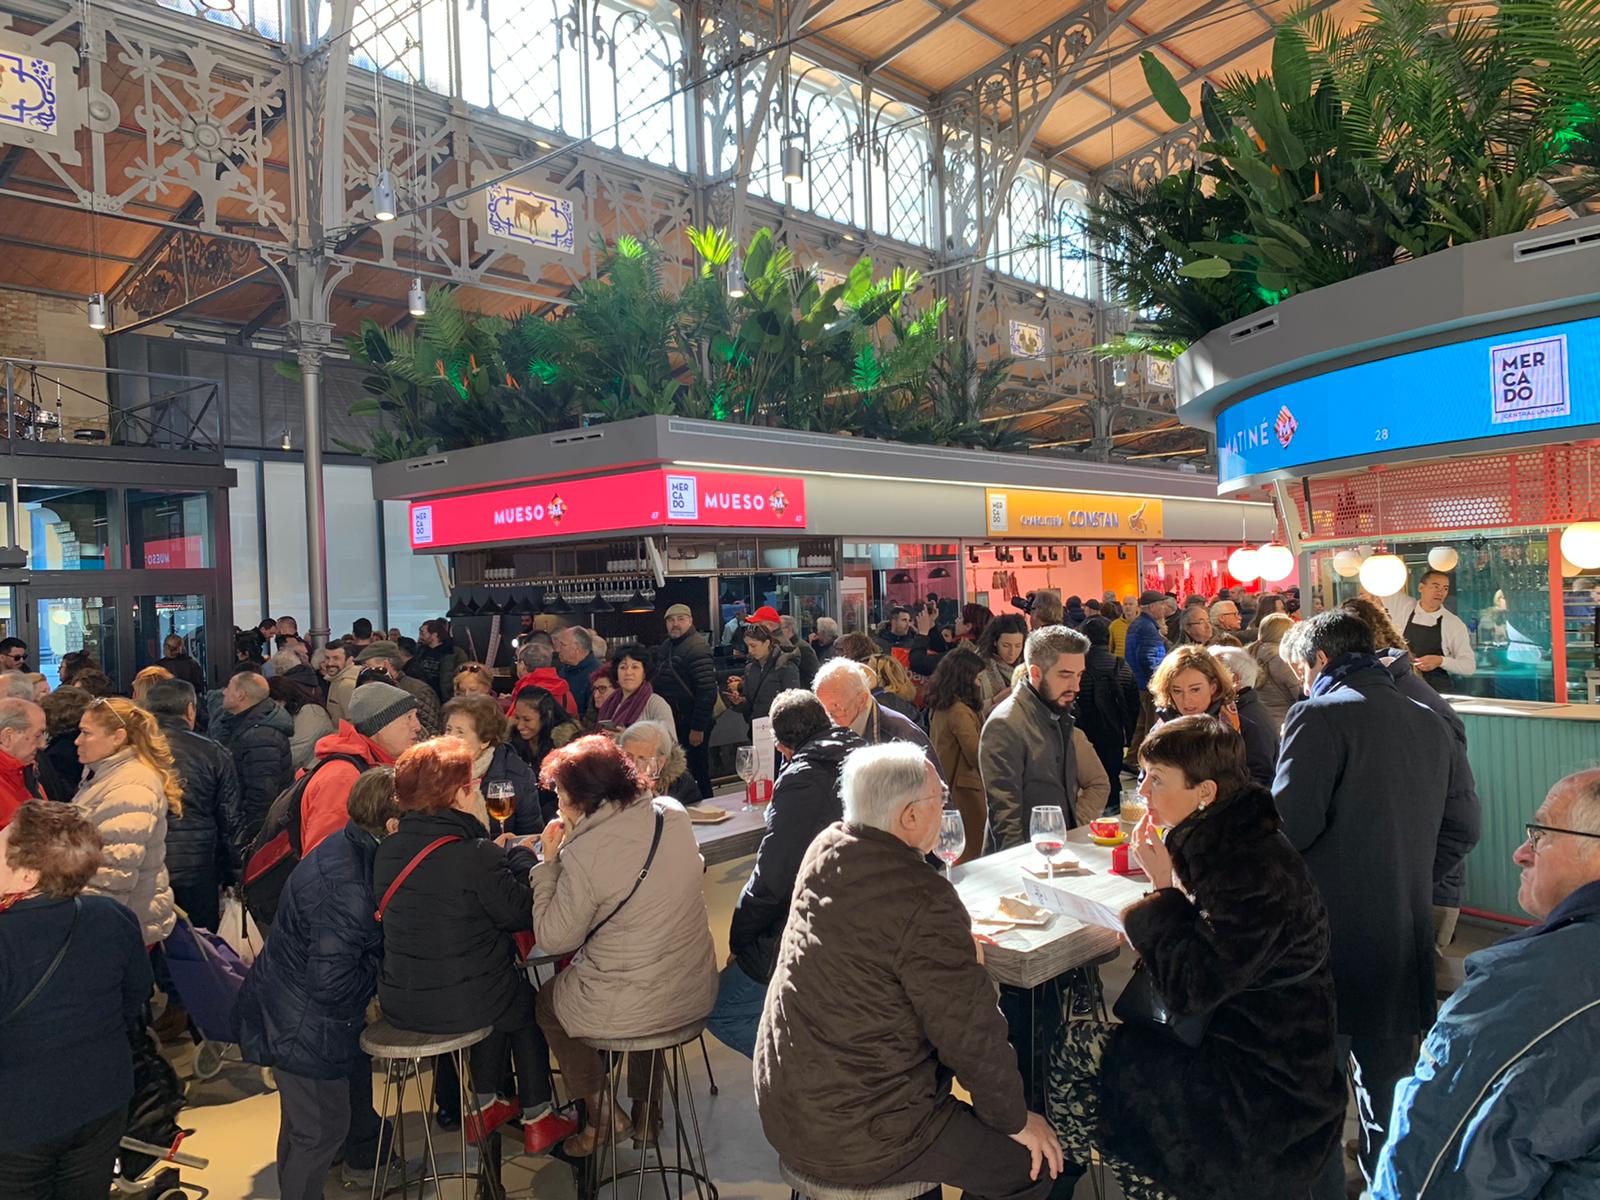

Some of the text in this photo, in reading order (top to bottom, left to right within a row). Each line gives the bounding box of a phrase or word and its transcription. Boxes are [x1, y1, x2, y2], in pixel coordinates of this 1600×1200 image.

[1502, 351, 1545, 372] MER
[1502, 371, 1530, 387] CA
[1503, 386, 1533, 403] DO
[1503, 410, 1536, 419] CENTRAL
[1224, 416, 1270, 457] MATINÉ
[1375, 428, 1389, 441] 28
[671, 482, 689, 491] MER
[672, 491, 684, 500] CA
[704, 492, 765, 511] MUESO
[672, 500, 685, 508] DO
[493, 504, 545, 525] MUESO
[1067, 510, 1119, 529] CONSTAN
